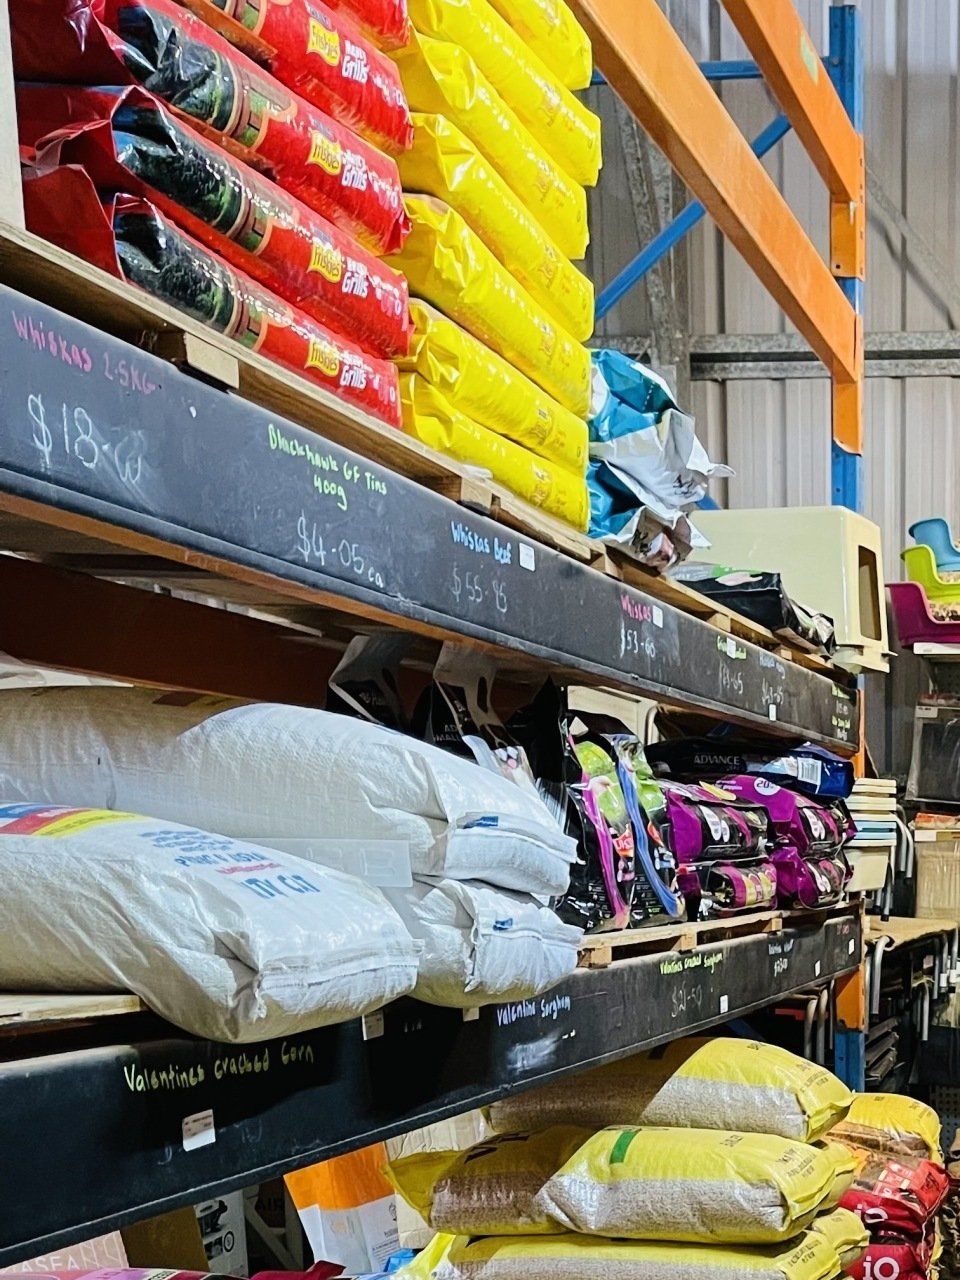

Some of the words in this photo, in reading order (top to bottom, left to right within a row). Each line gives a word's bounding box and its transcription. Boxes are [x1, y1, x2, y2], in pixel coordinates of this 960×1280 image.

[342, 56, 369, 83] Grills
[342, 165, 367, 191] Grills
[341, 272, 368, 298] Grills
[340, 366, 367, 389] Grills
[313, 475, 347, 511] 400g
[365, 472, 387, 495] Tins
[451, 521, 490, 555] Whiskas
[694, 755, 741, 767] ADVANCE
[123, 1062, 205, 1093] Valentines
[281, 1041, 314, 1065] Corn
